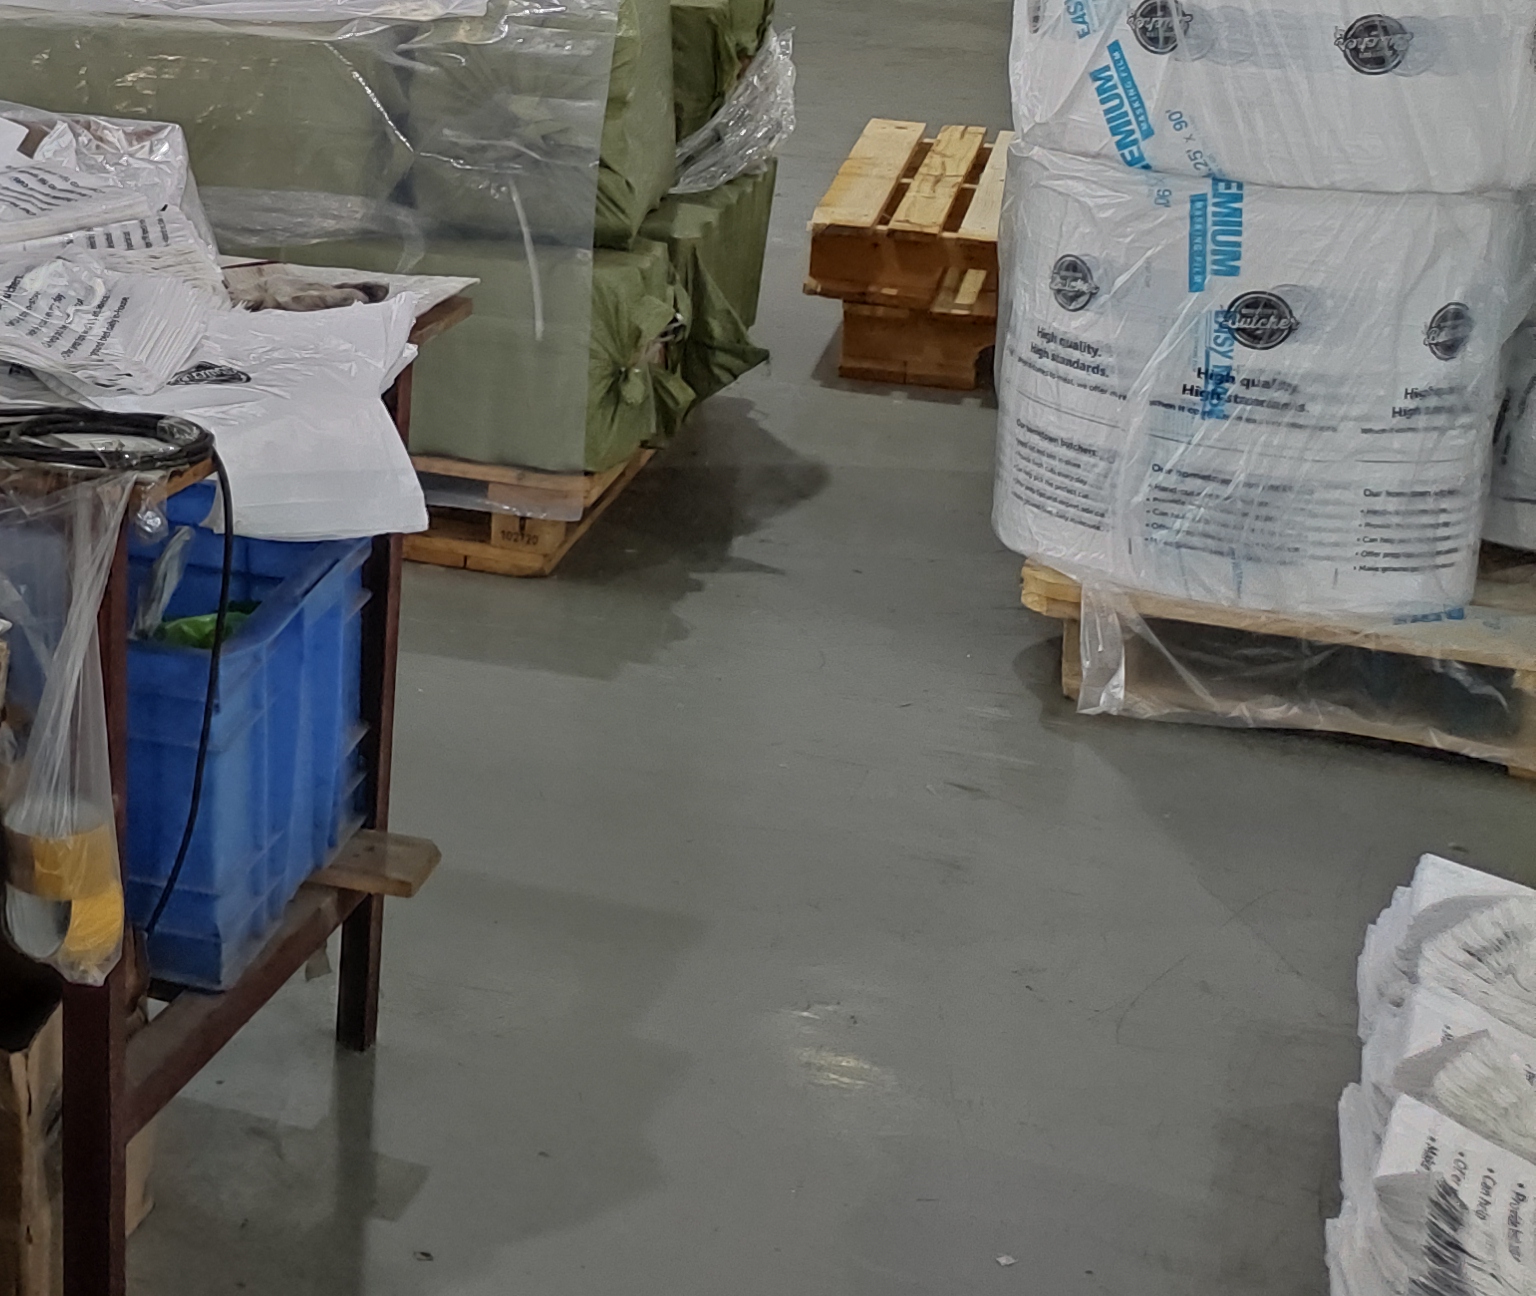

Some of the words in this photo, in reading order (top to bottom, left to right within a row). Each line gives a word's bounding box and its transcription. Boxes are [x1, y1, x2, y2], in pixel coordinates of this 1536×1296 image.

[1037, 326, 1057, 344] High
[1060, 336, 1102, 357] quality.
[1030, 342, 1050, 359] High
[1051, 352, 1109, 378] standards.
